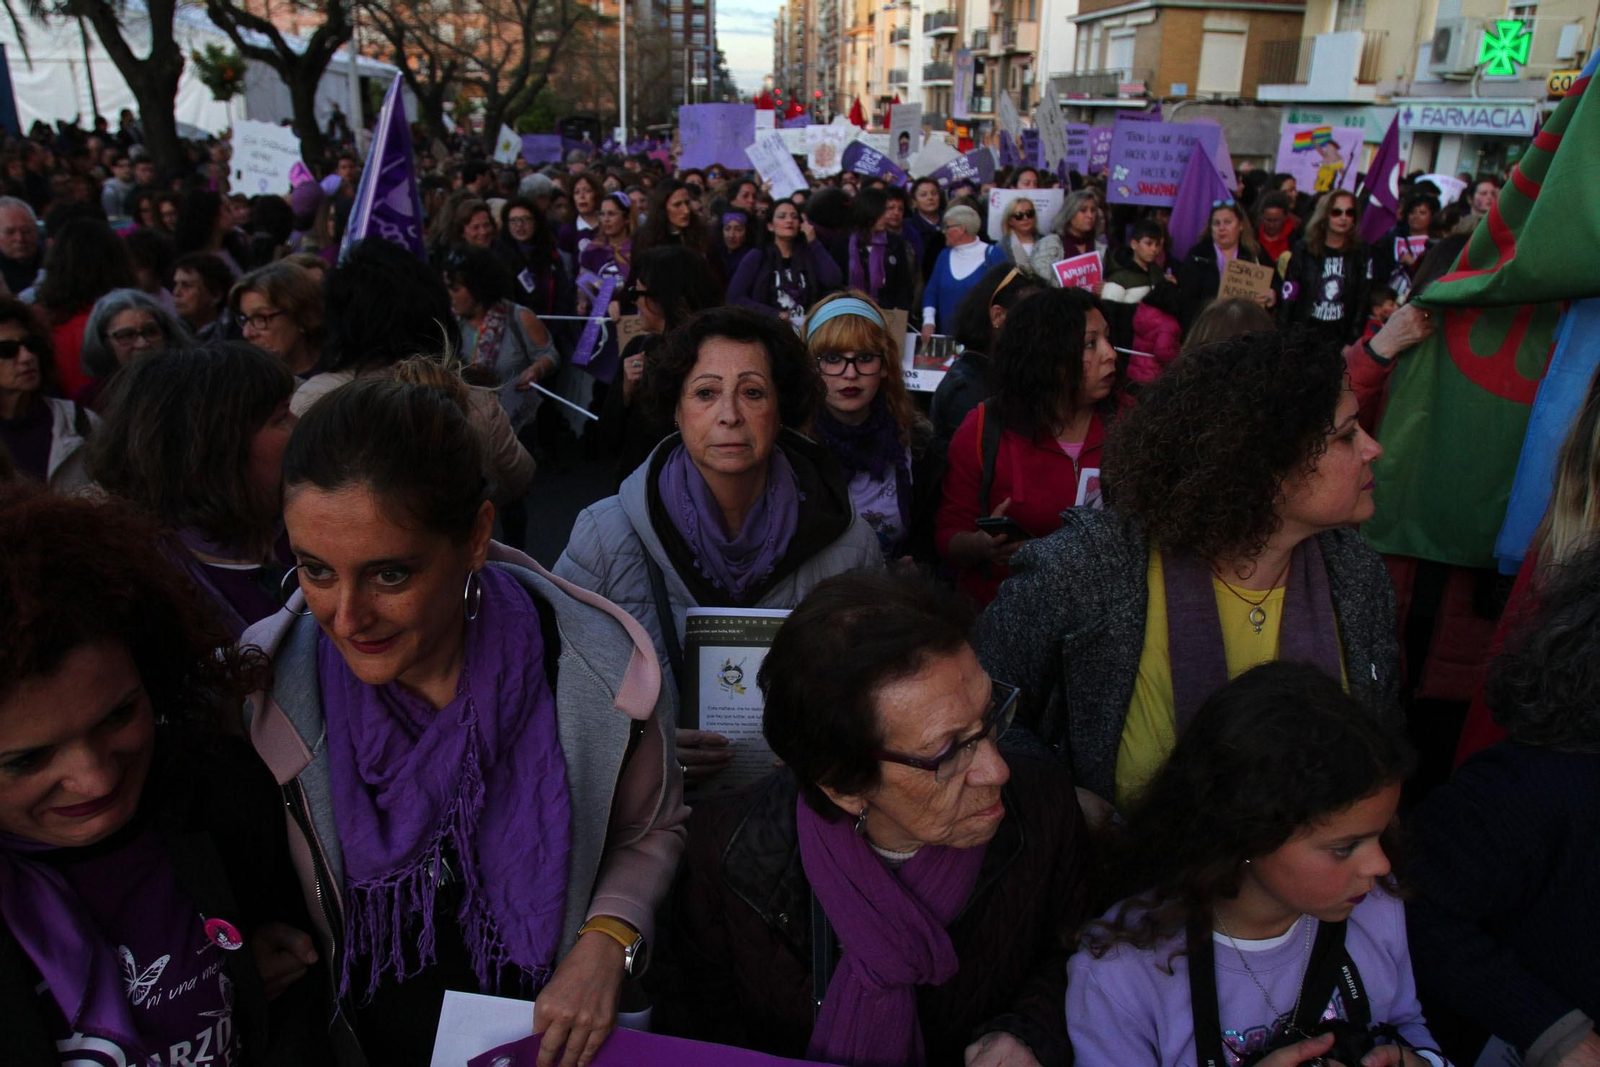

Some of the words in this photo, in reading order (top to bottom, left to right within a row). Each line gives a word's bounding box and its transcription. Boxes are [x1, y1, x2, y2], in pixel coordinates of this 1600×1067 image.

[1420, 107, 1526, 129] FARMACIA
[1063, 263, 1097, 280] APUNTA
[146, 988, 163, 1009] ni
[168, 975, 198, 1000] una
[1341, 965, 1359, 999] FUJIFILM
